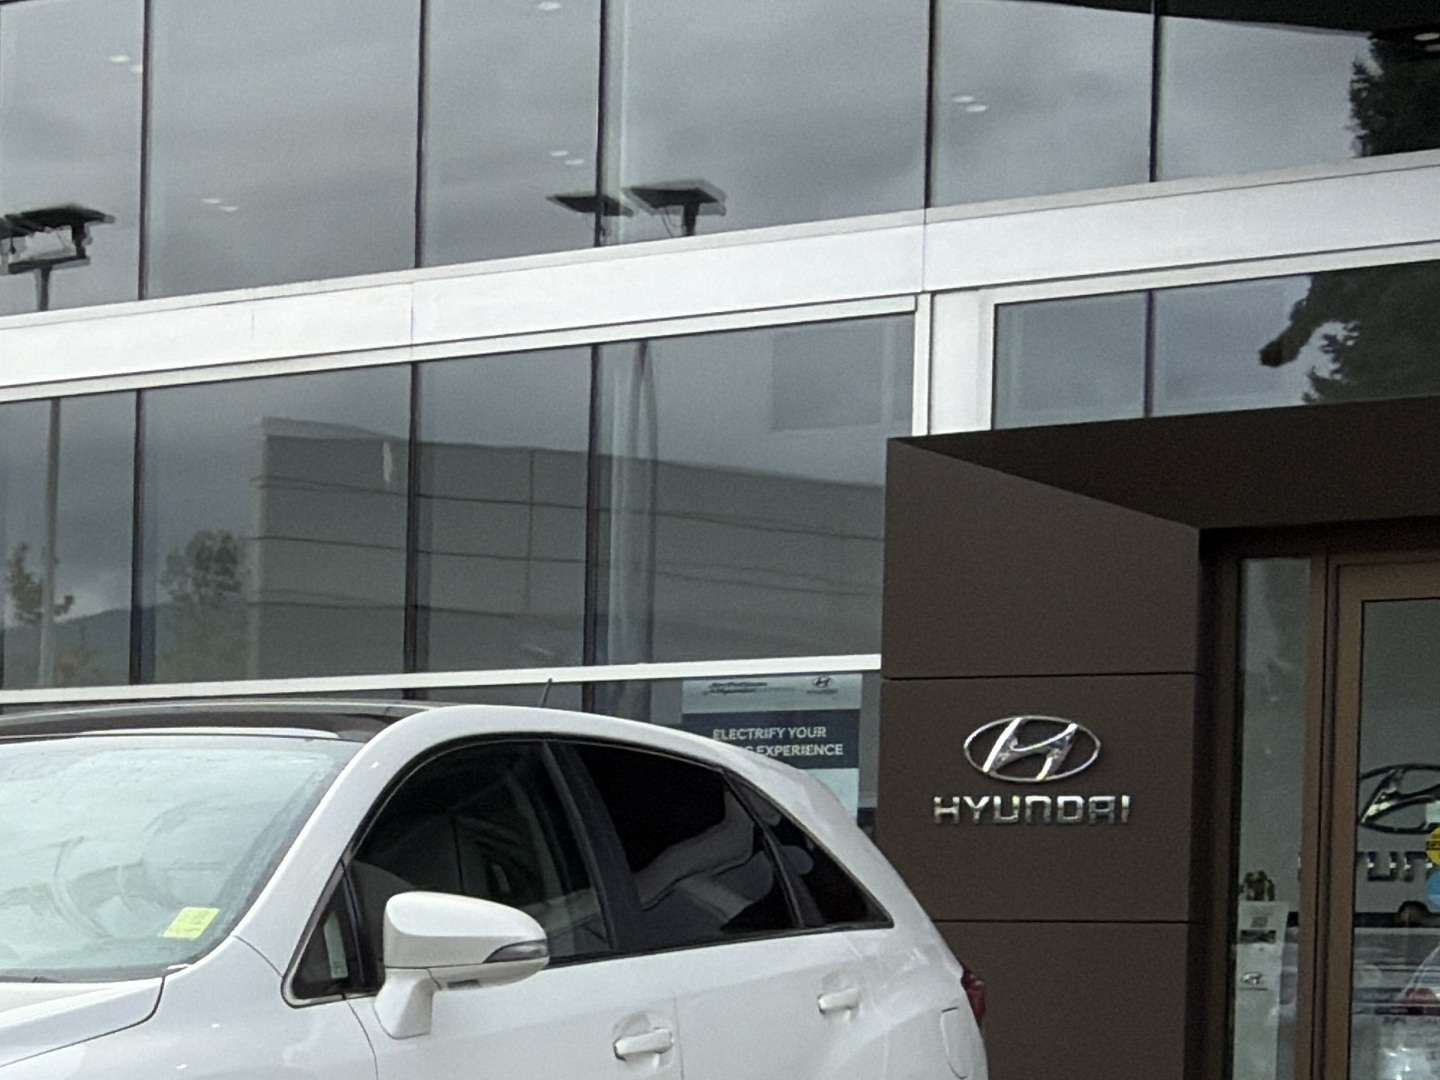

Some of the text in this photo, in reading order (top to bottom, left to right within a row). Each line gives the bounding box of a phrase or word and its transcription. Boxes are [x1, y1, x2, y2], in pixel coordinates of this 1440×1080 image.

[713, 726, 827, 741] ELECTRIFY YOUR
[757, 744, 844, 757] EXPERIENCE
[933, 795, 1131, 824] HYUNDAI
